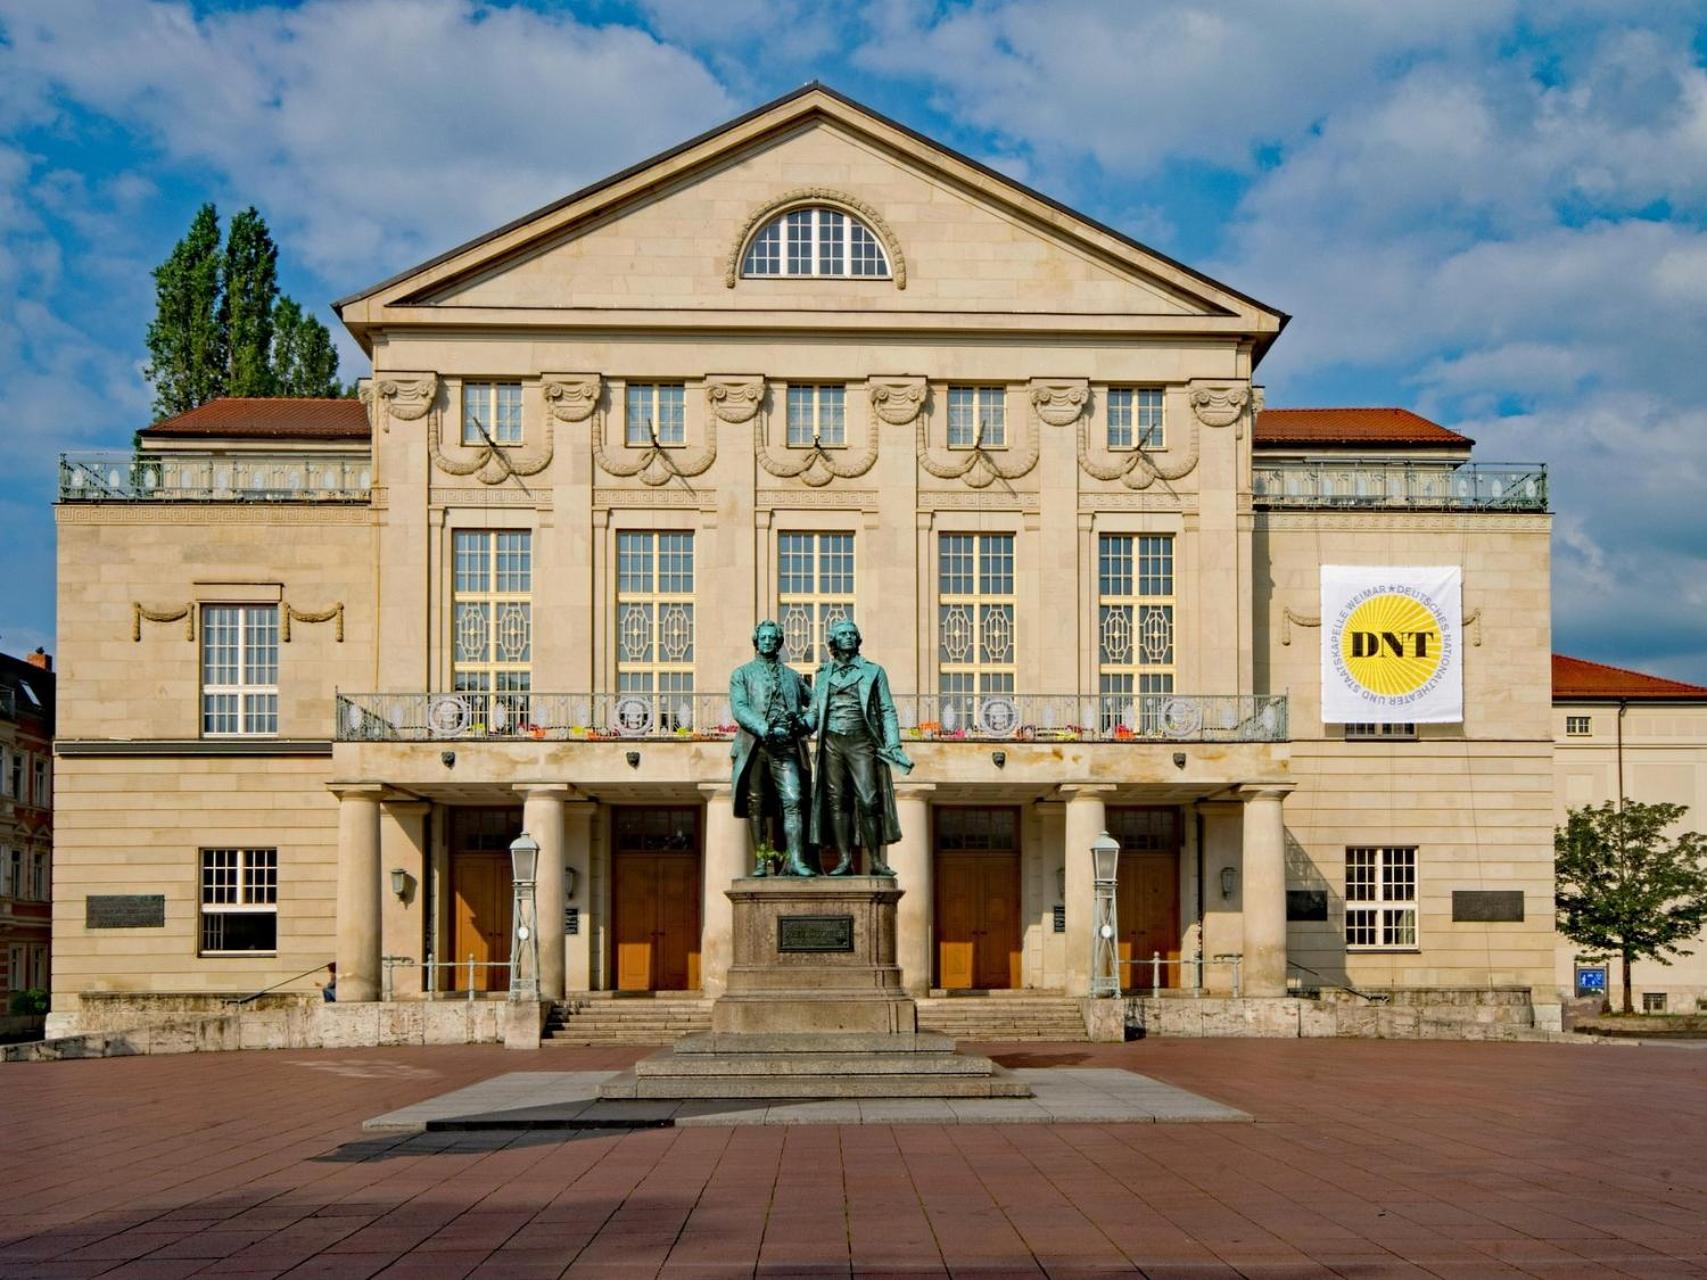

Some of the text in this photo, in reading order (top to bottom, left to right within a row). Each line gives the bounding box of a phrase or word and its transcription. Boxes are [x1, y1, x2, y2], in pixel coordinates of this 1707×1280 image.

[1330, 585, 1452, 705] DEUTSCHES NATIONALTHEATER UND STAATSKAPELLE WEIMAR
[1350, 631, 1434, 658] DNT
